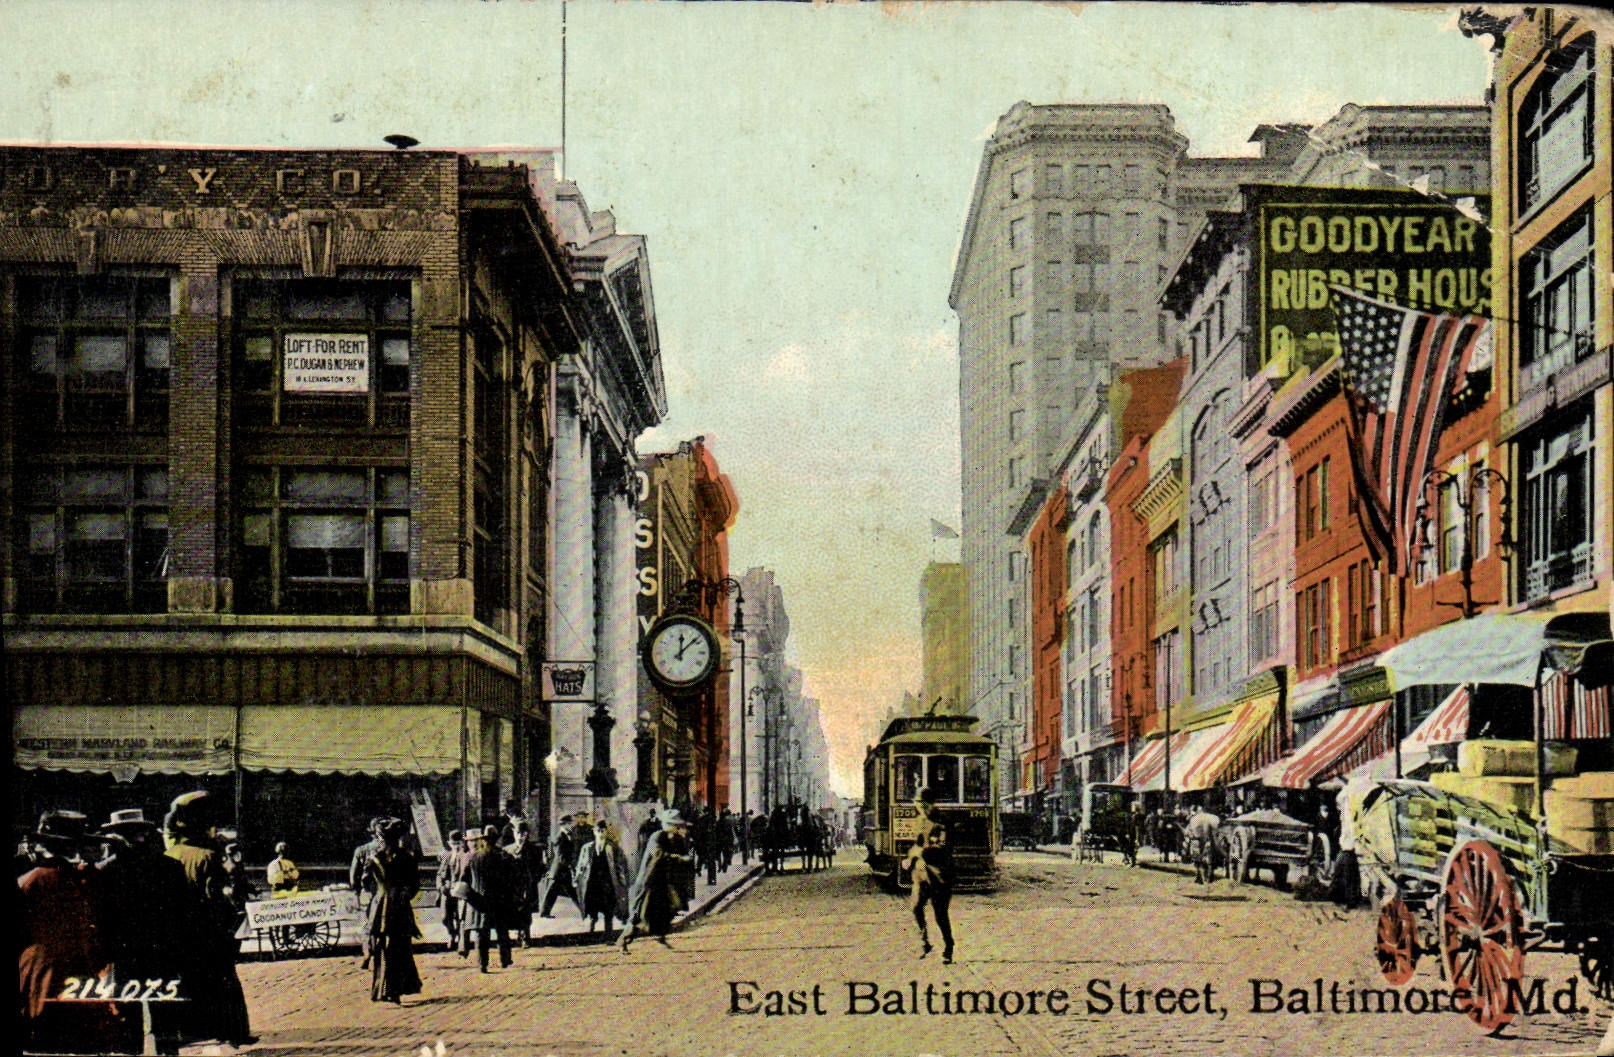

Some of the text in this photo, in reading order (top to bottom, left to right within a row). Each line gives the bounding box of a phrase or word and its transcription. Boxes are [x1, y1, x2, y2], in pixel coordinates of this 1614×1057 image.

[1270, 215, 1477, 253] GOODYEAR
[315, 339, 336, 354] FOR
[338, 339, 366, 354] RENT
[334, 358, 365, 370] NEPHEW
[555, 680, 582, 694] HATS
[253, 910, 297, 924] COCOANUT
[299, 907, 327, 919] CANDY
